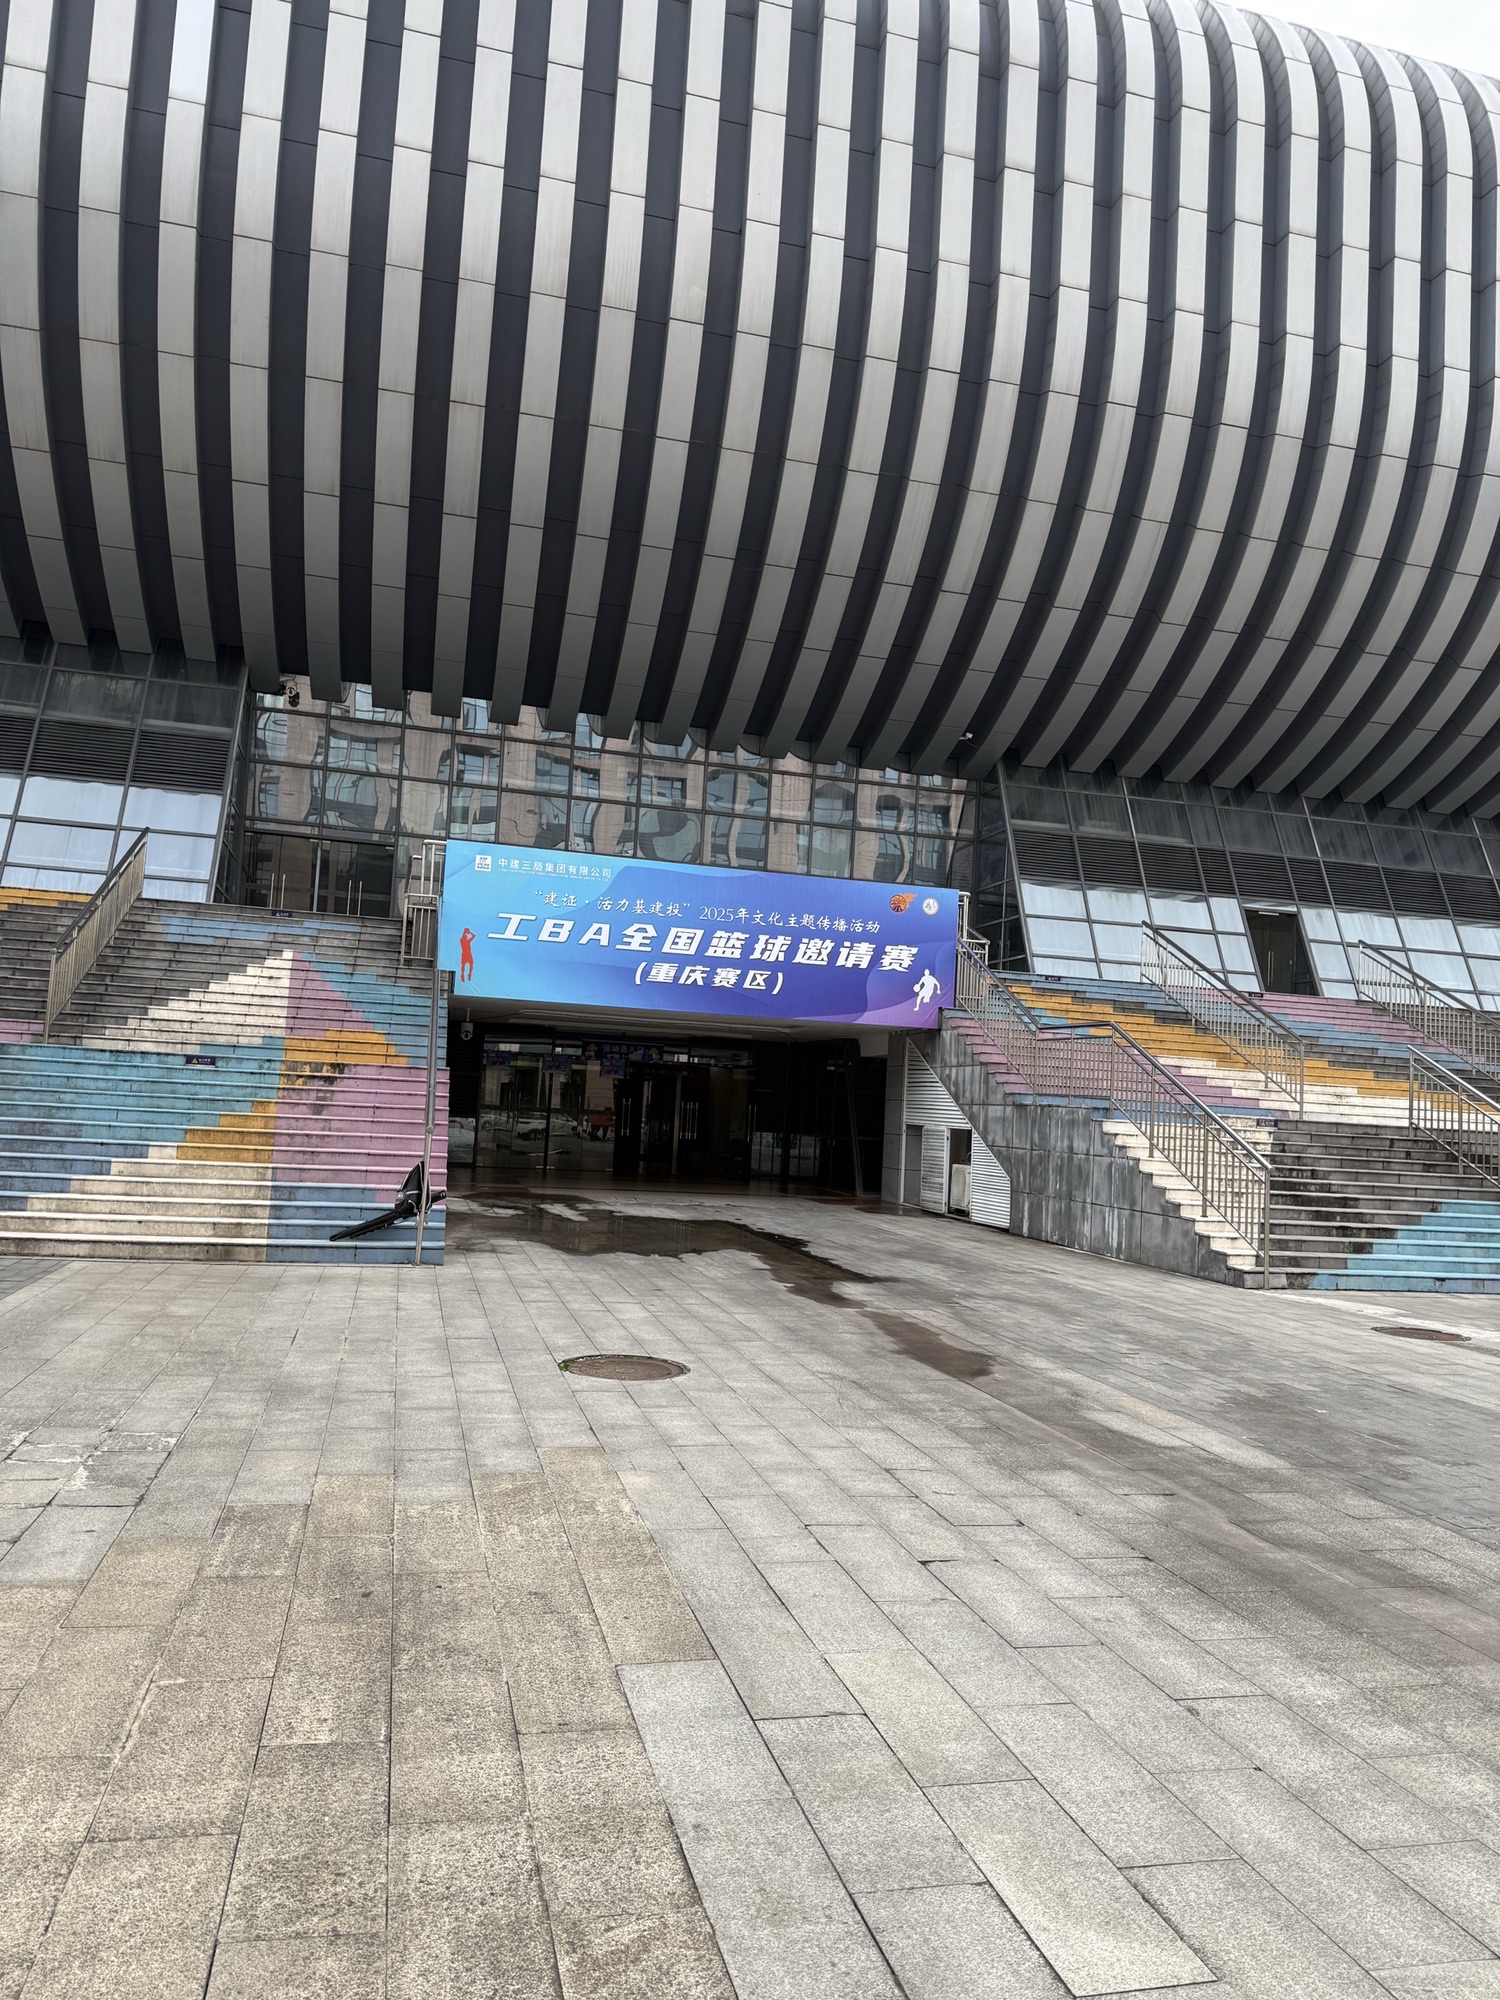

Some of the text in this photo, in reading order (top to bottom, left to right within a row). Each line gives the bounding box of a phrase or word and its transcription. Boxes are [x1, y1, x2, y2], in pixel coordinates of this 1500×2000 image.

[498, 858, 611, 878] 中建三局集团有限公司
[699, 906, 881, 934] 2025年文化主题传播活动
[487, 912, 920, 973] 工BA全国篮球邀请赛
